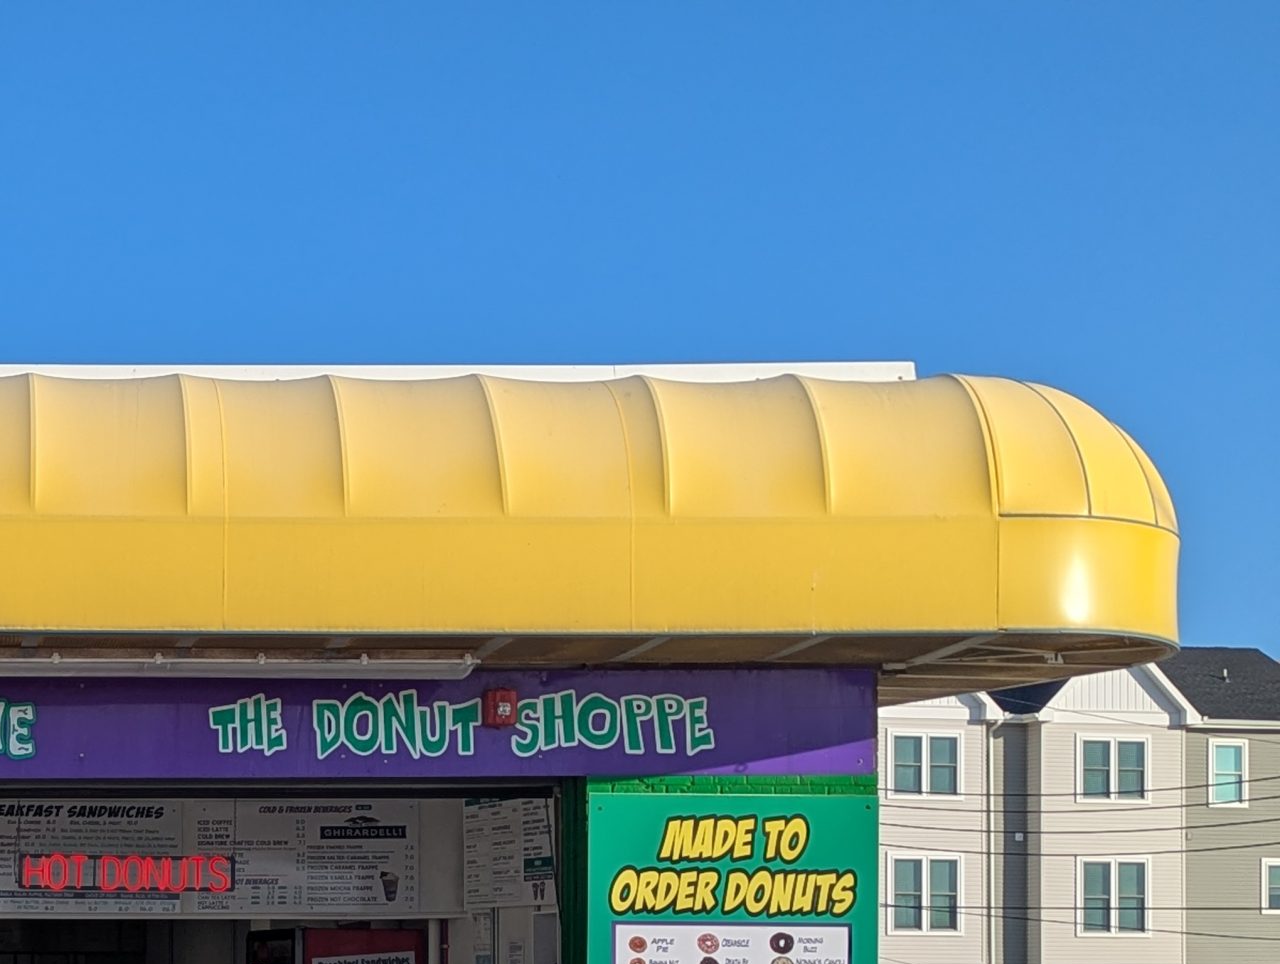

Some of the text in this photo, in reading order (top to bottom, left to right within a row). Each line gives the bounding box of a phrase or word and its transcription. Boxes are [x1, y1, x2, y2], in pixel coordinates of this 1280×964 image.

[209, 689, 714, 759] THE DONUT SHOPPE
[67, 805, 164, 819] SANDWICHES
[324, 829, 402, 837] GHIRARDELLI
[657, 813, 810, 863] MADE TO
[24, 854, 231, 892] HOT DONUTS
[609, 865, 857, 918] ORDER DONUTS
